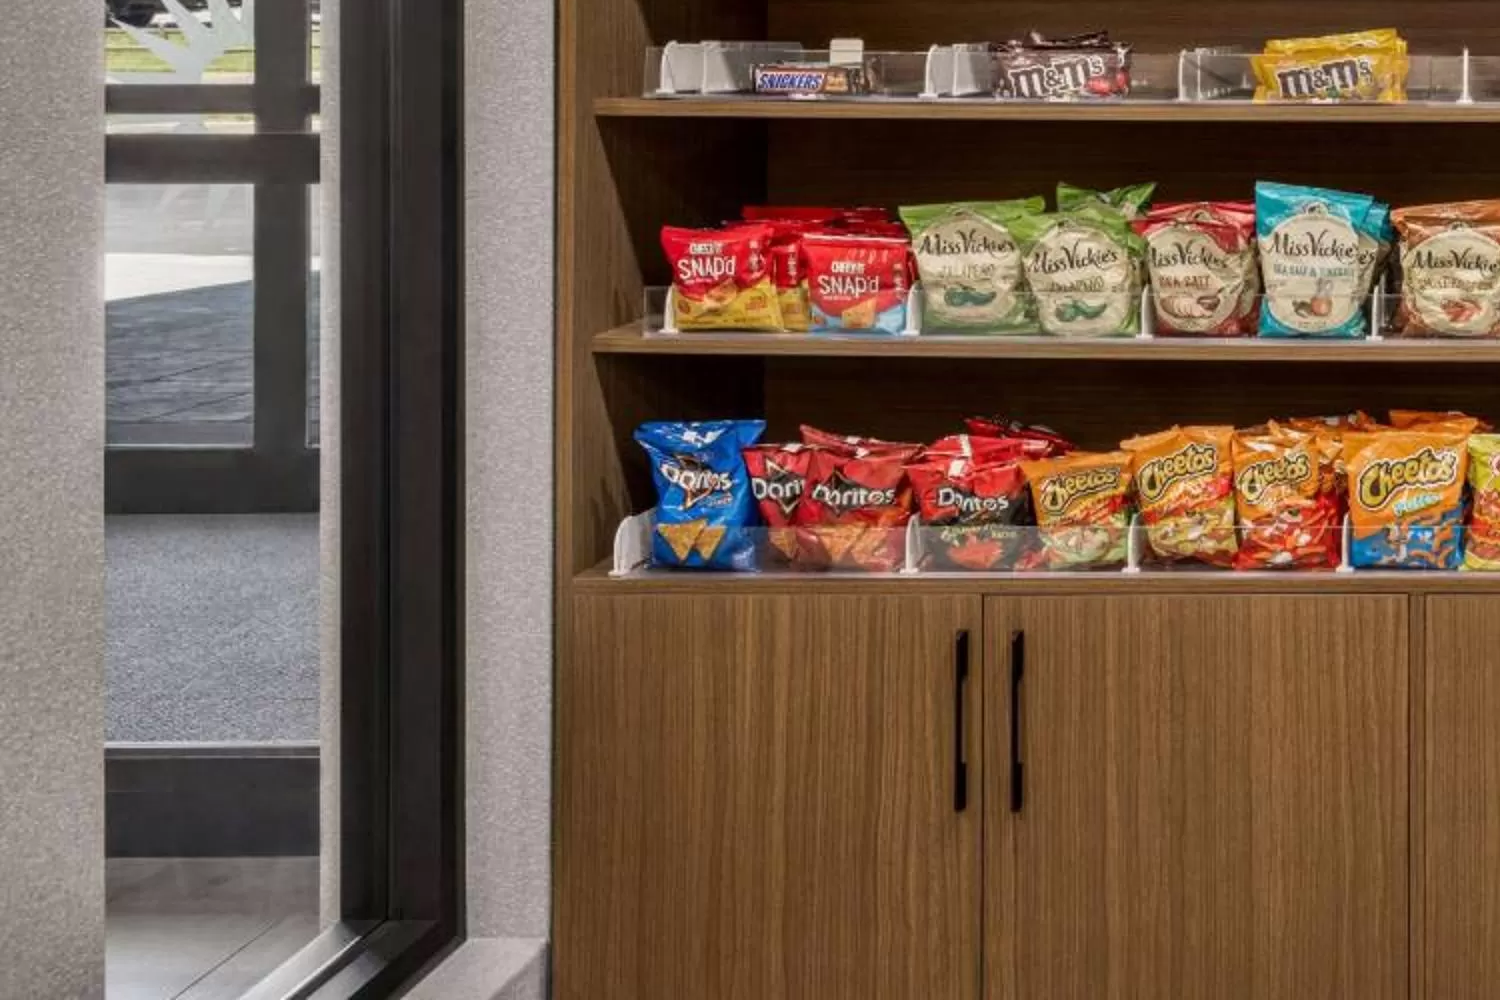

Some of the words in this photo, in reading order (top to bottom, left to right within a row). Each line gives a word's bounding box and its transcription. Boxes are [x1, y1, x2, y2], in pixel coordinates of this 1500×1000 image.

[759, 73, 822, 89] SNICKERS
[811, 483, 896, 506] Doritos
[1040, 465, 1121, 513] Cheetos
[1140, 442, 1217, 502] Cheetos
[1237, 450, 1313, 503] Cheetos
[1358, 448, 1457, 509] Cheetos
